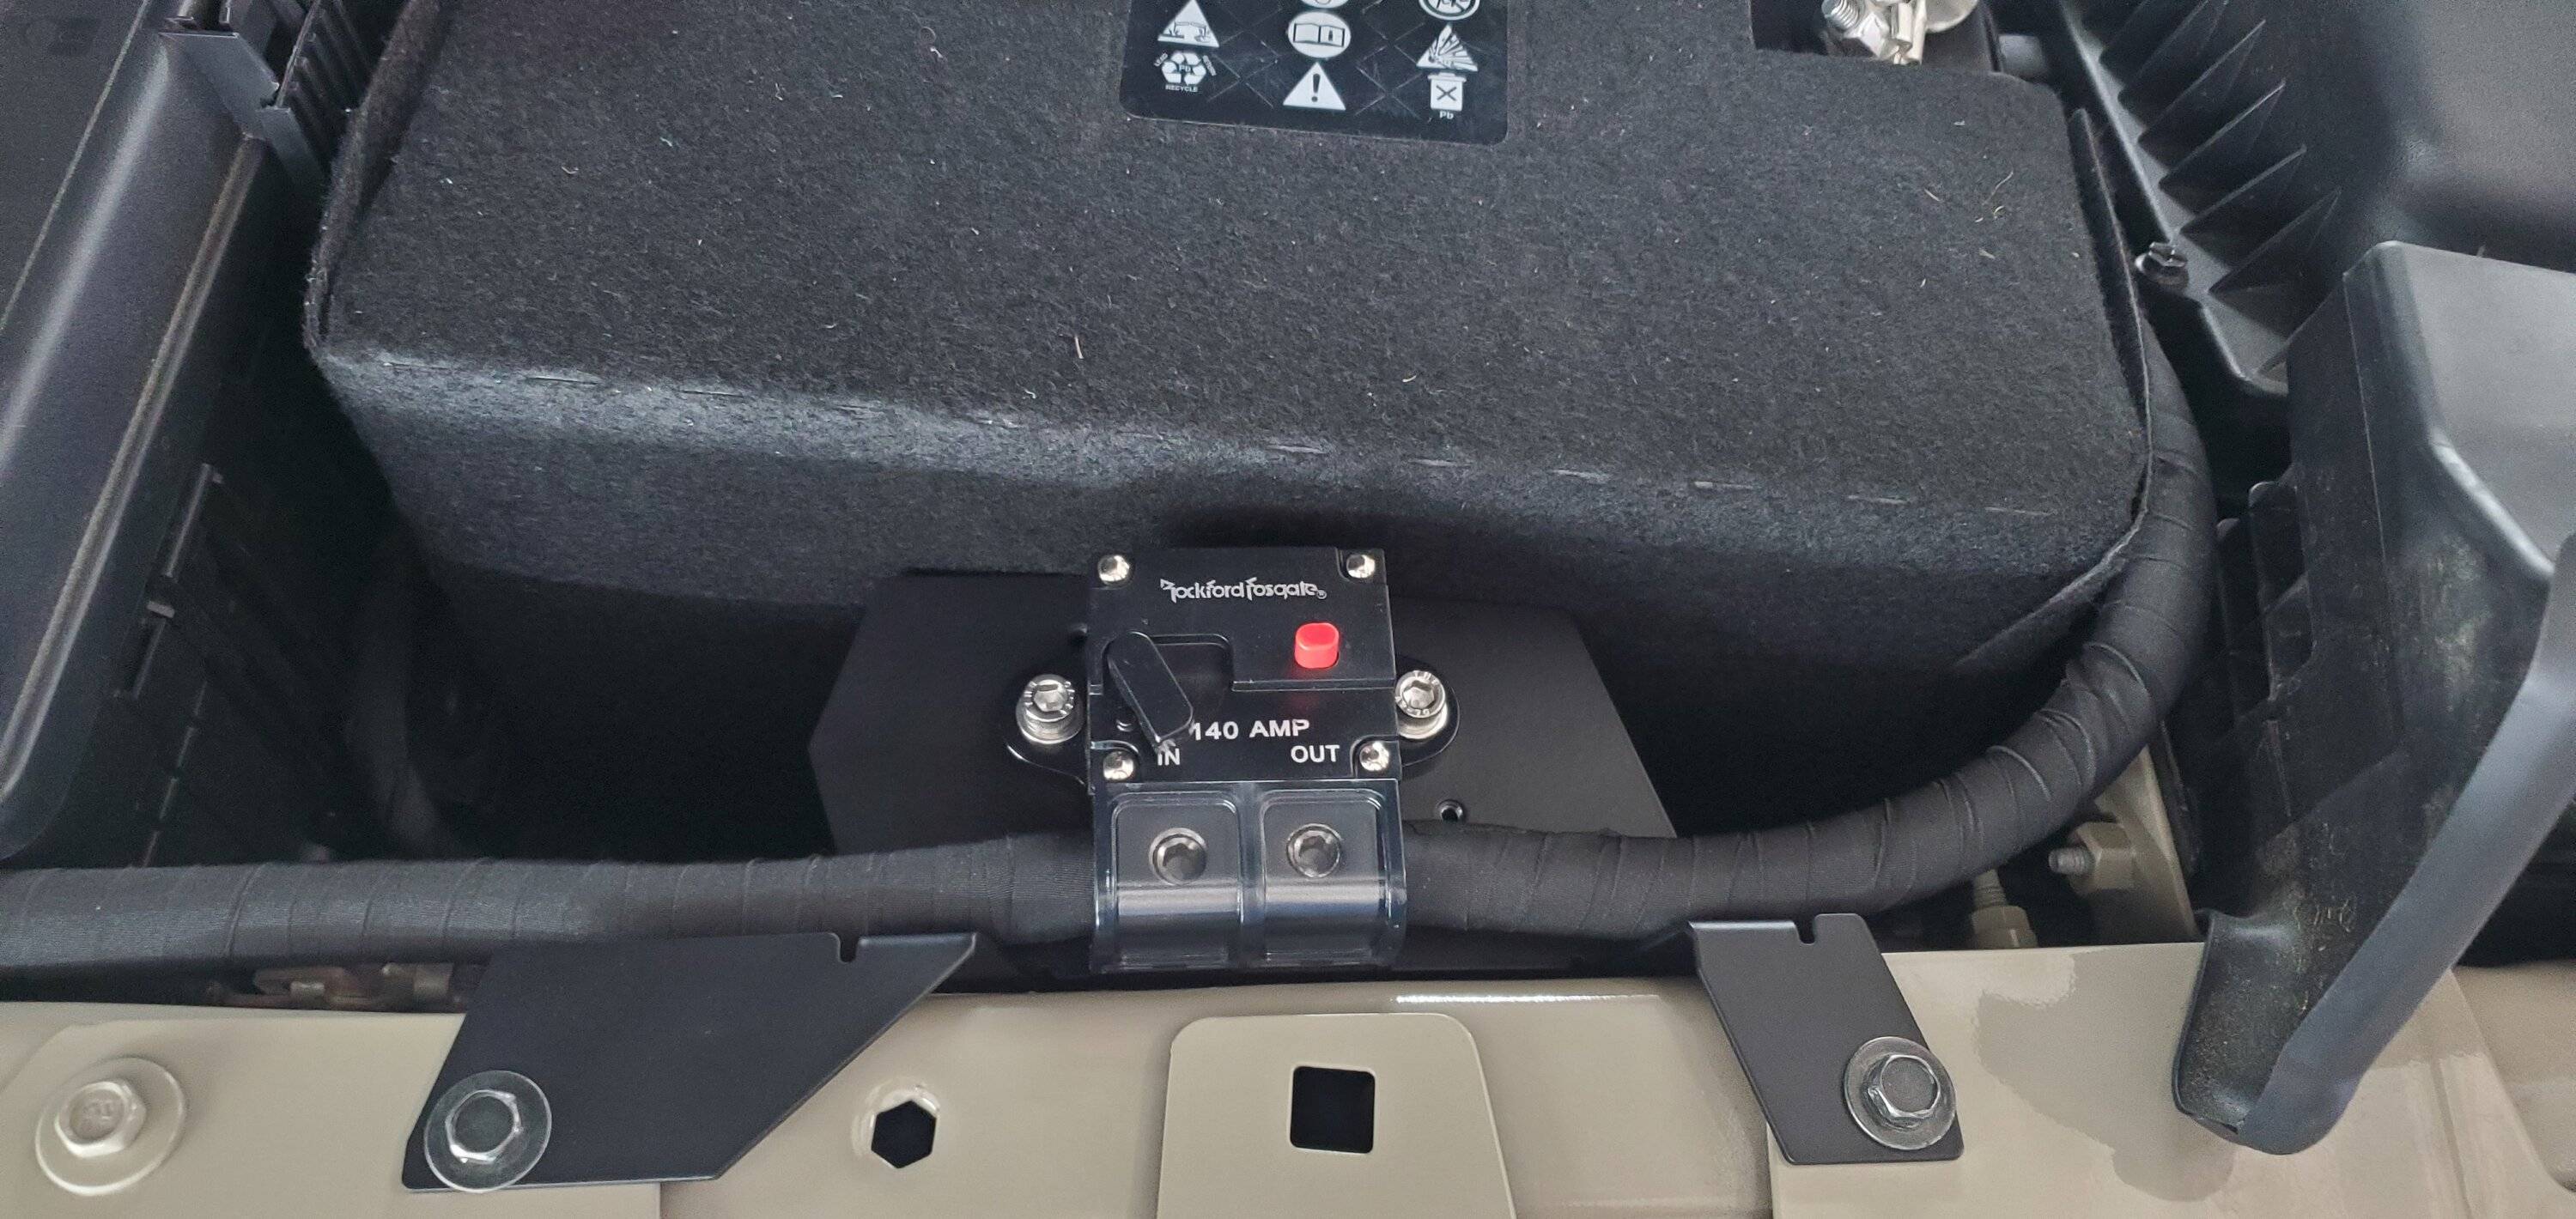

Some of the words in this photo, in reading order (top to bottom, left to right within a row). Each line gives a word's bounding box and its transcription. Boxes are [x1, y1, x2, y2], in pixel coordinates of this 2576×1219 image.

[1439, 111, 1455, 120] Pb
[1193, 721, 1239, 741] 140
[1249, 719, 1310, 738] AMP
[1157, 748, 1181, 766] IN
[1291, 744, 1340, 763] OUT
